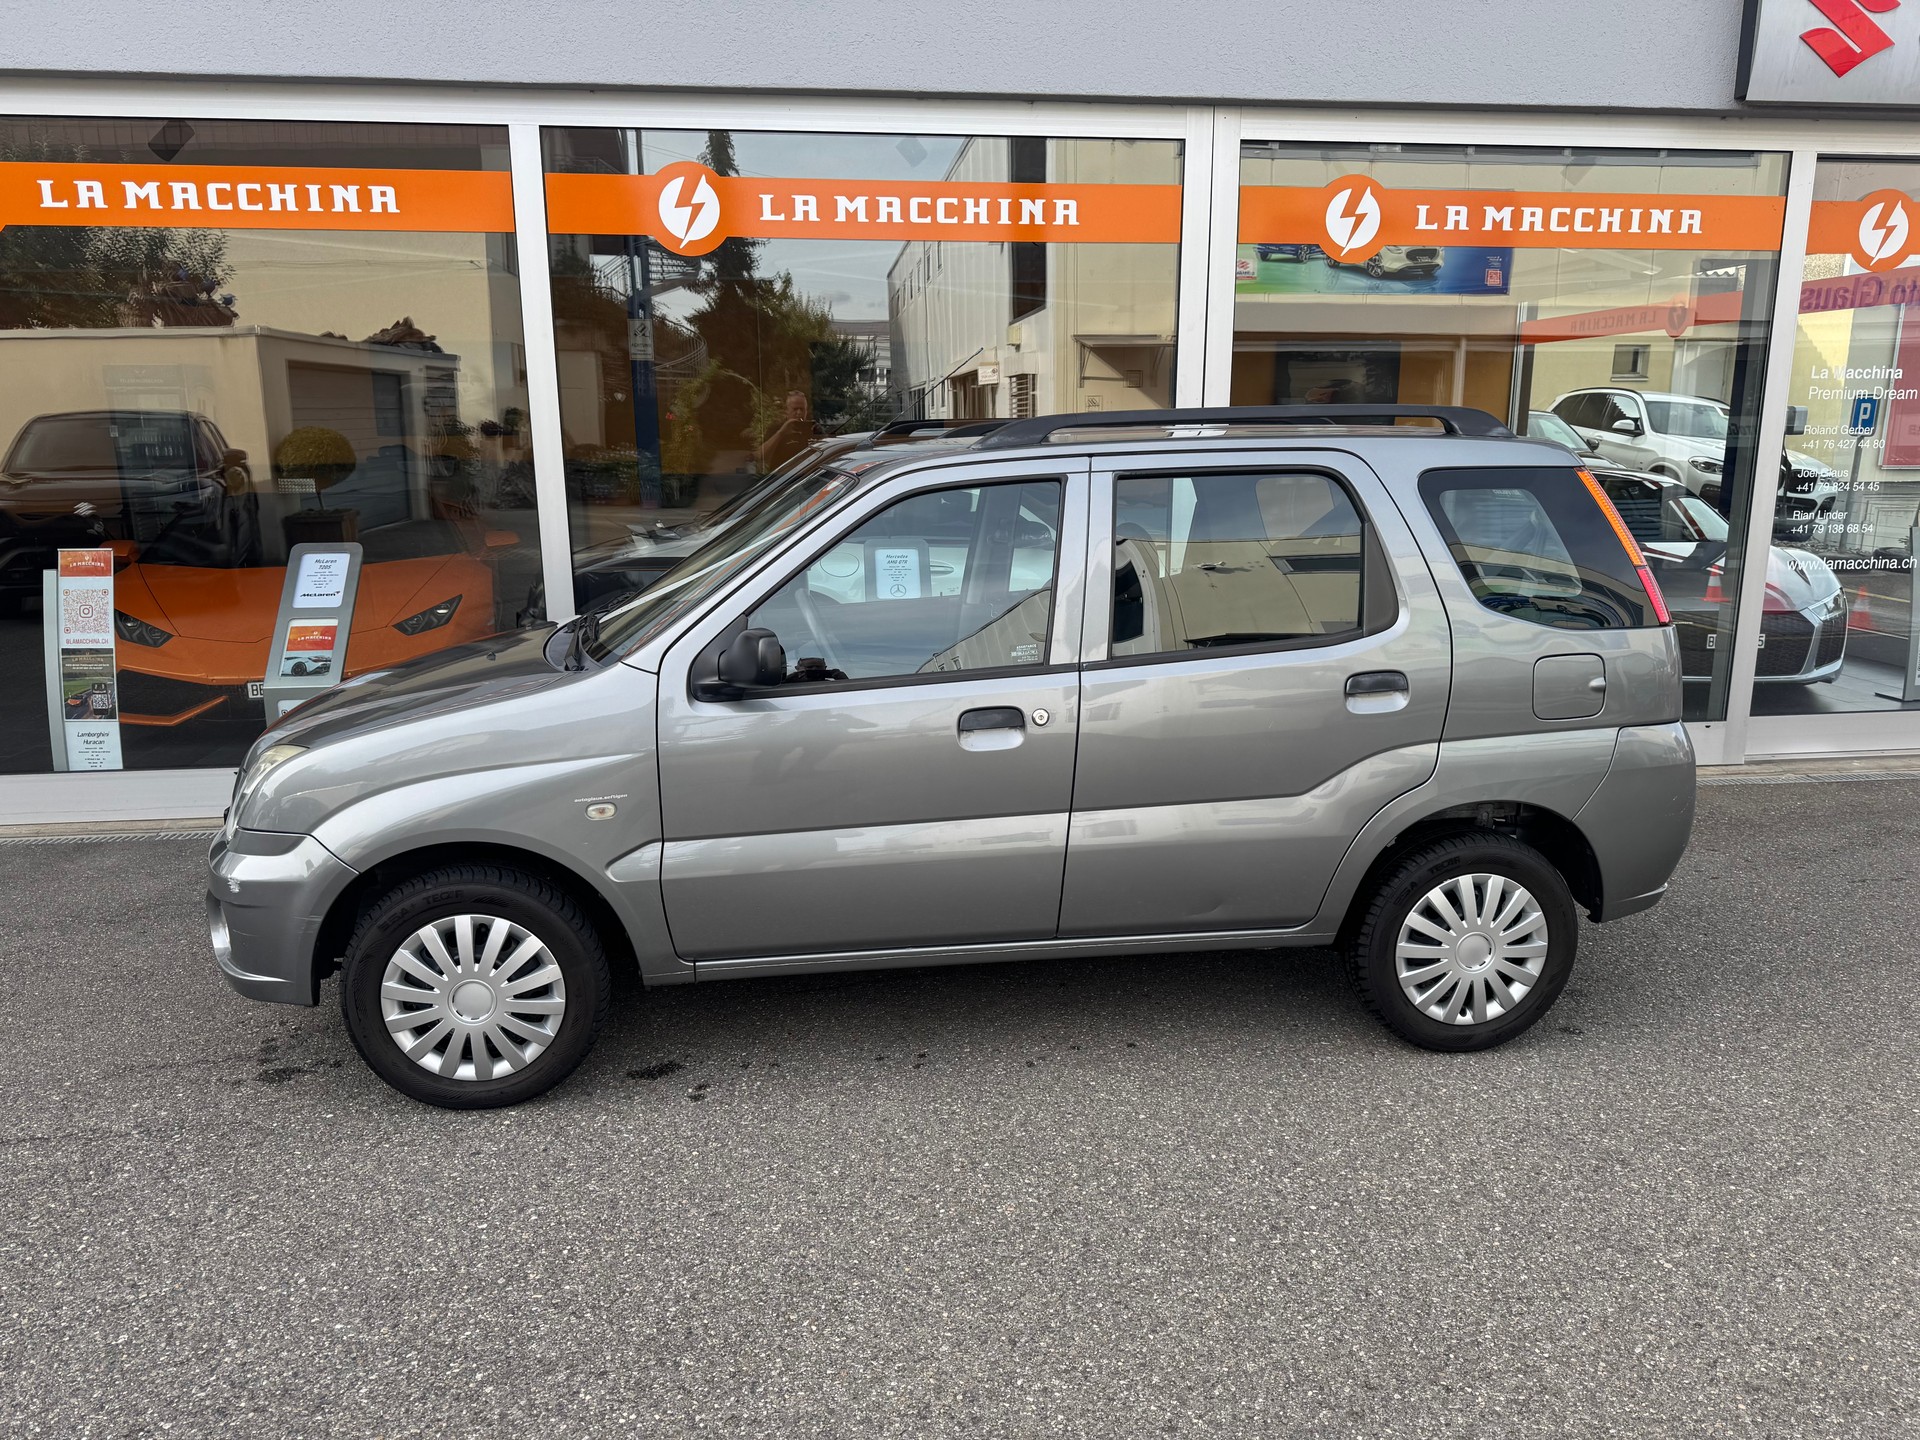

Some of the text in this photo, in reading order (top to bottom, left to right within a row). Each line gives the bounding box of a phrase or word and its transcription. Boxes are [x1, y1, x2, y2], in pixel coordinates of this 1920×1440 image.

[36, 179, 401, 213] LA MACCHINA
[759, 193, 1080, 226] LA MACCHINA
[1414, 204, 1702, 234] LA MACCHINA
[1811, 365, 1903, 379] La Macchina
[1808, 386, 1918, 400] Premium Dream
[1803, 424, 1875, 435] Roland Gerber
[1802, 439, 1885, 449] +41 76 427 44 80
[1796, 482, 1880, 492] +41 79 824 54 45
[1793, 510, 1848, 520] Rian Linder
[1791, 523, 1874, 534] +41 79 138 68 54
[1787, 555, 1918, 570] www.lamacchina.ch
[76, 731, 110, 739] Lamborghini
